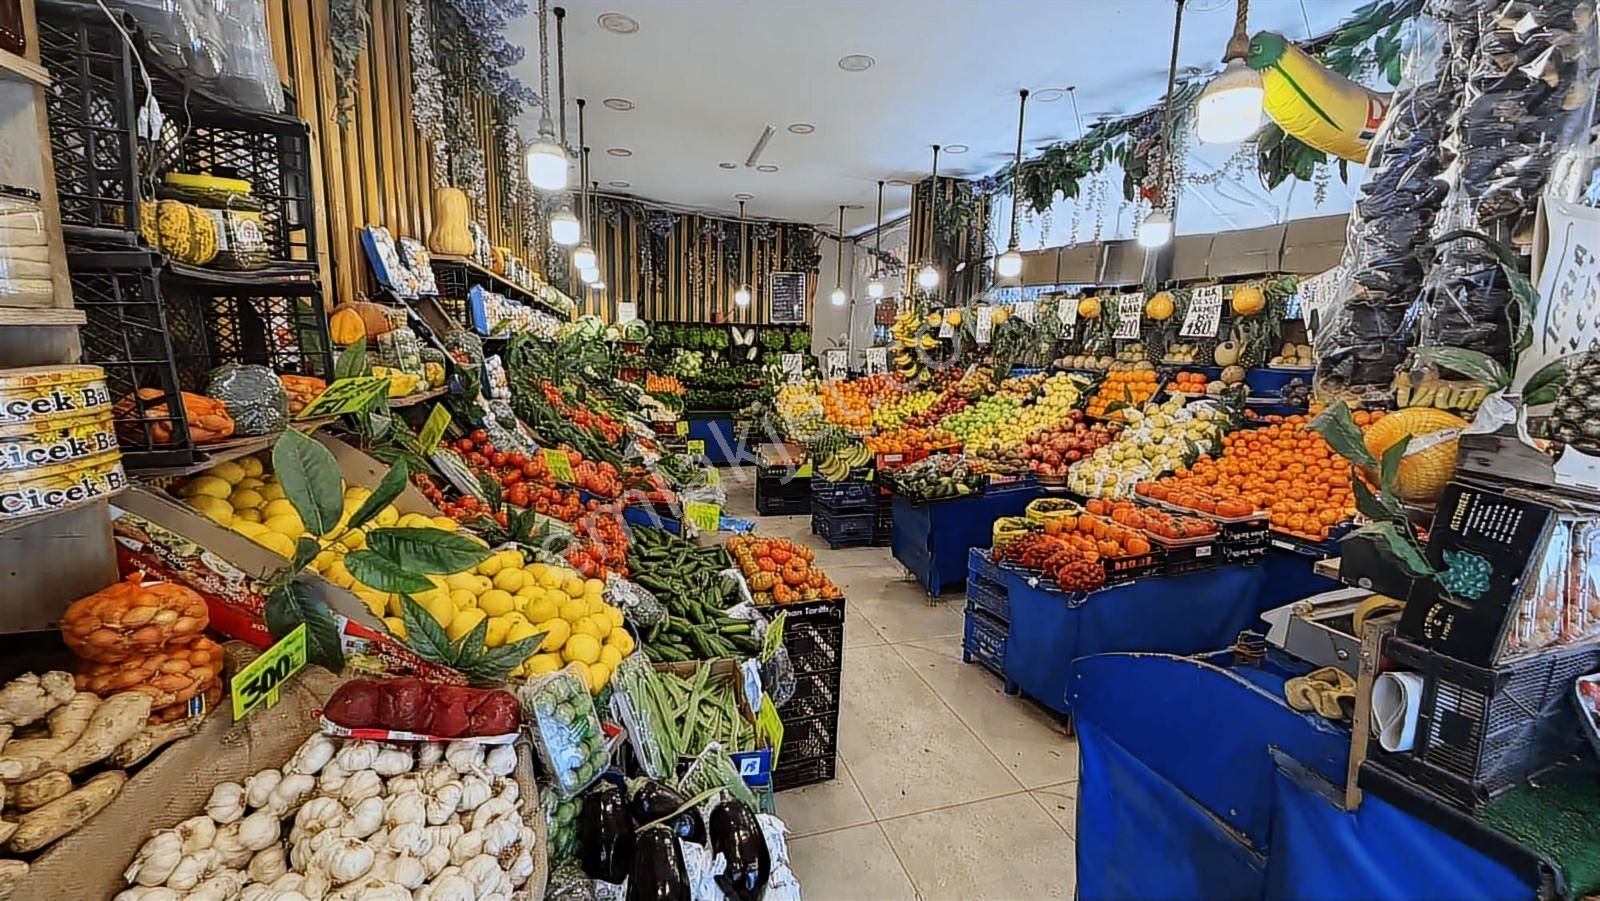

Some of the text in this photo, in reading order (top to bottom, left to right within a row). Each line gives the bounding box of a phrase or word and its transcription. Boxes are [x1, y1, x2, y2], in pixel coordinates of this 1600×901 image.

[1187, 320, 1212, 335] 180
[0, 391, 75, 420] çek
[240, 654, 291, 709] 300
